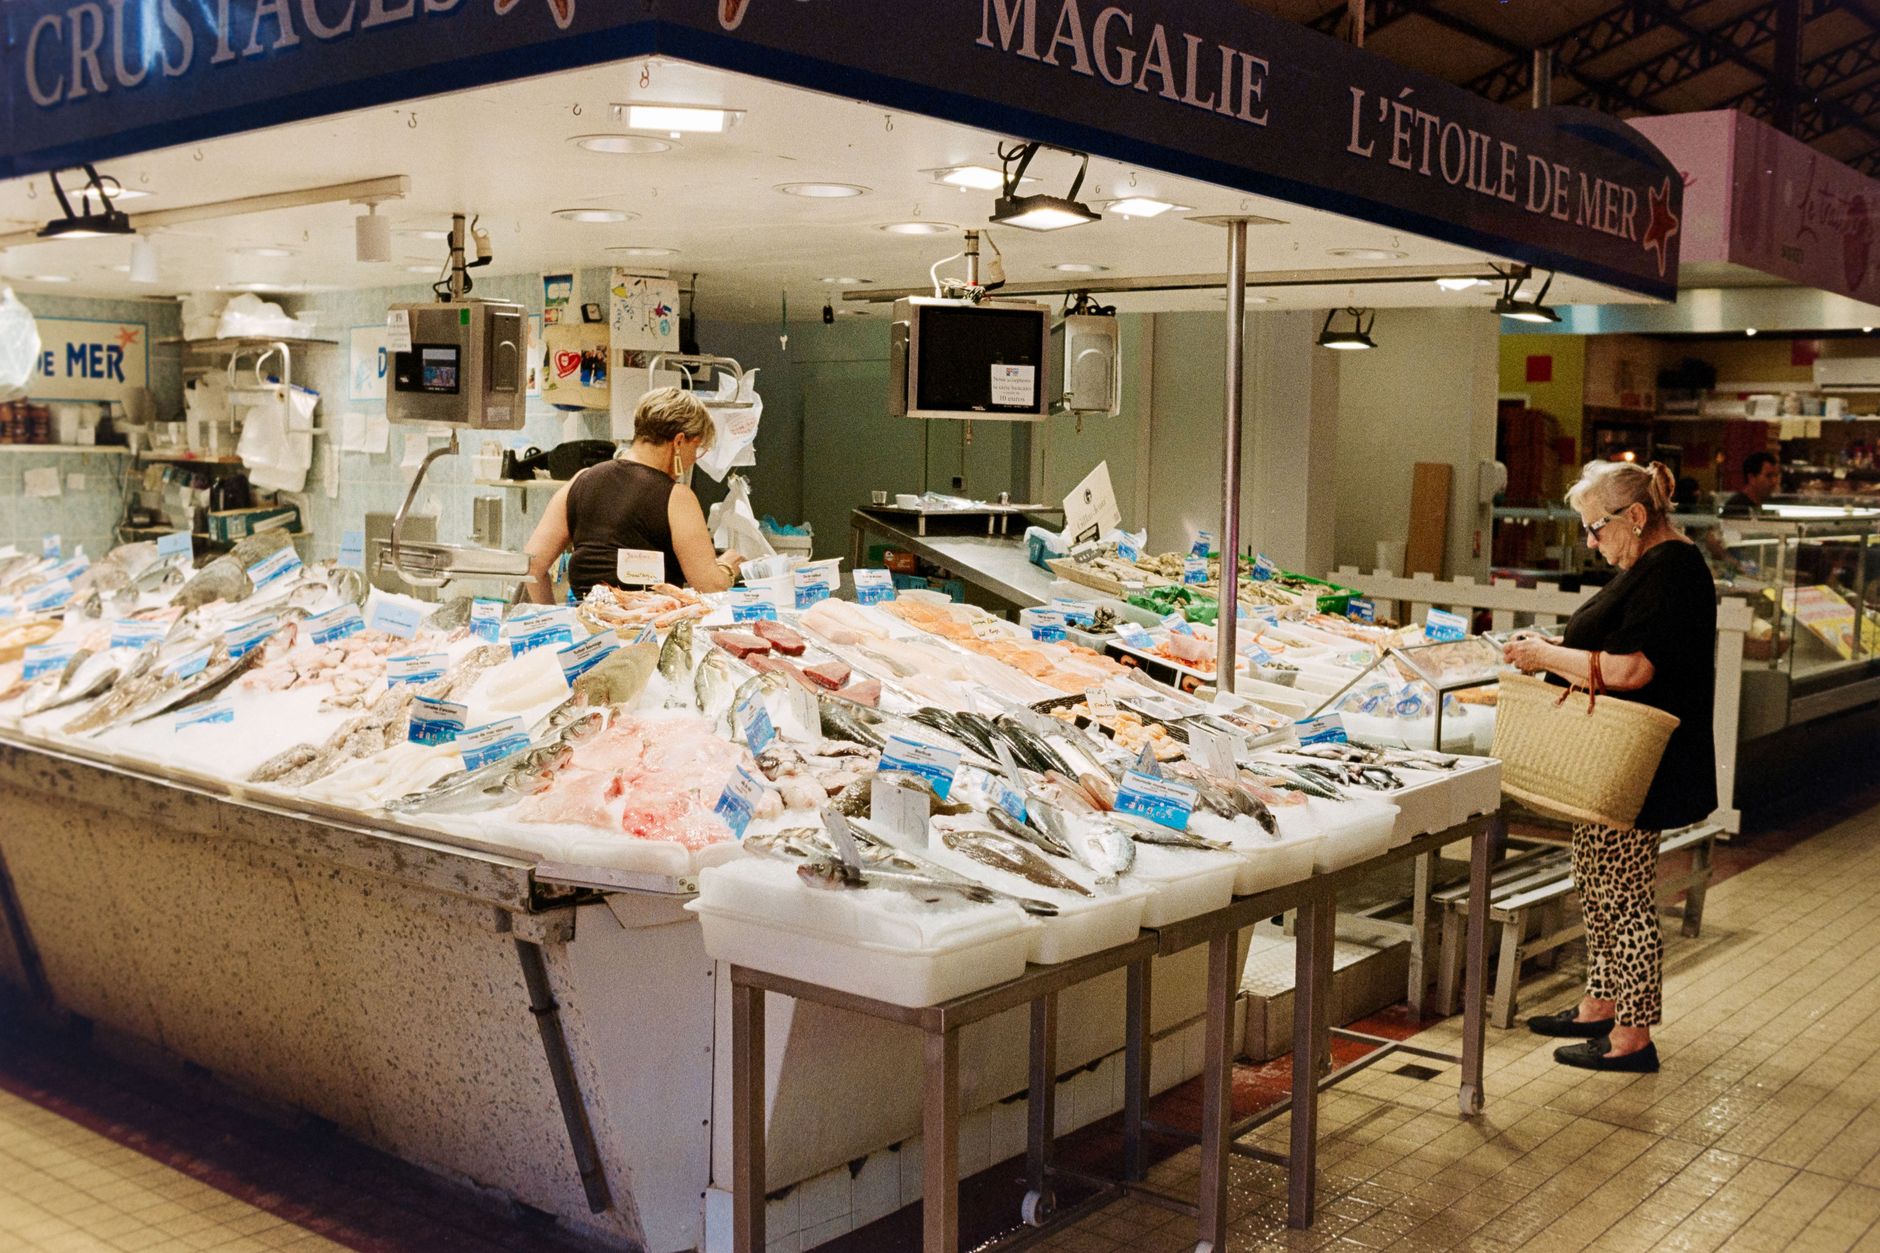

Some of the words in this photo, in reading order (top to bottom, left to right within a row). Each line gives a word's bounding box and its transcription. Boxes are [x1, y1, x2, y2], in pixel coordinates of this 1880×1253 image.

[25, 0, 458, 106] CRUSTA
[975, 0, 1269, 126] MAGALIE
[1347, 86, 1518, 202] L'ÉTOILE
[1526, 155, 1570, 222] DE
[1576, 172, 1638, 242] MER
[66, 342, 125, 383] MER
